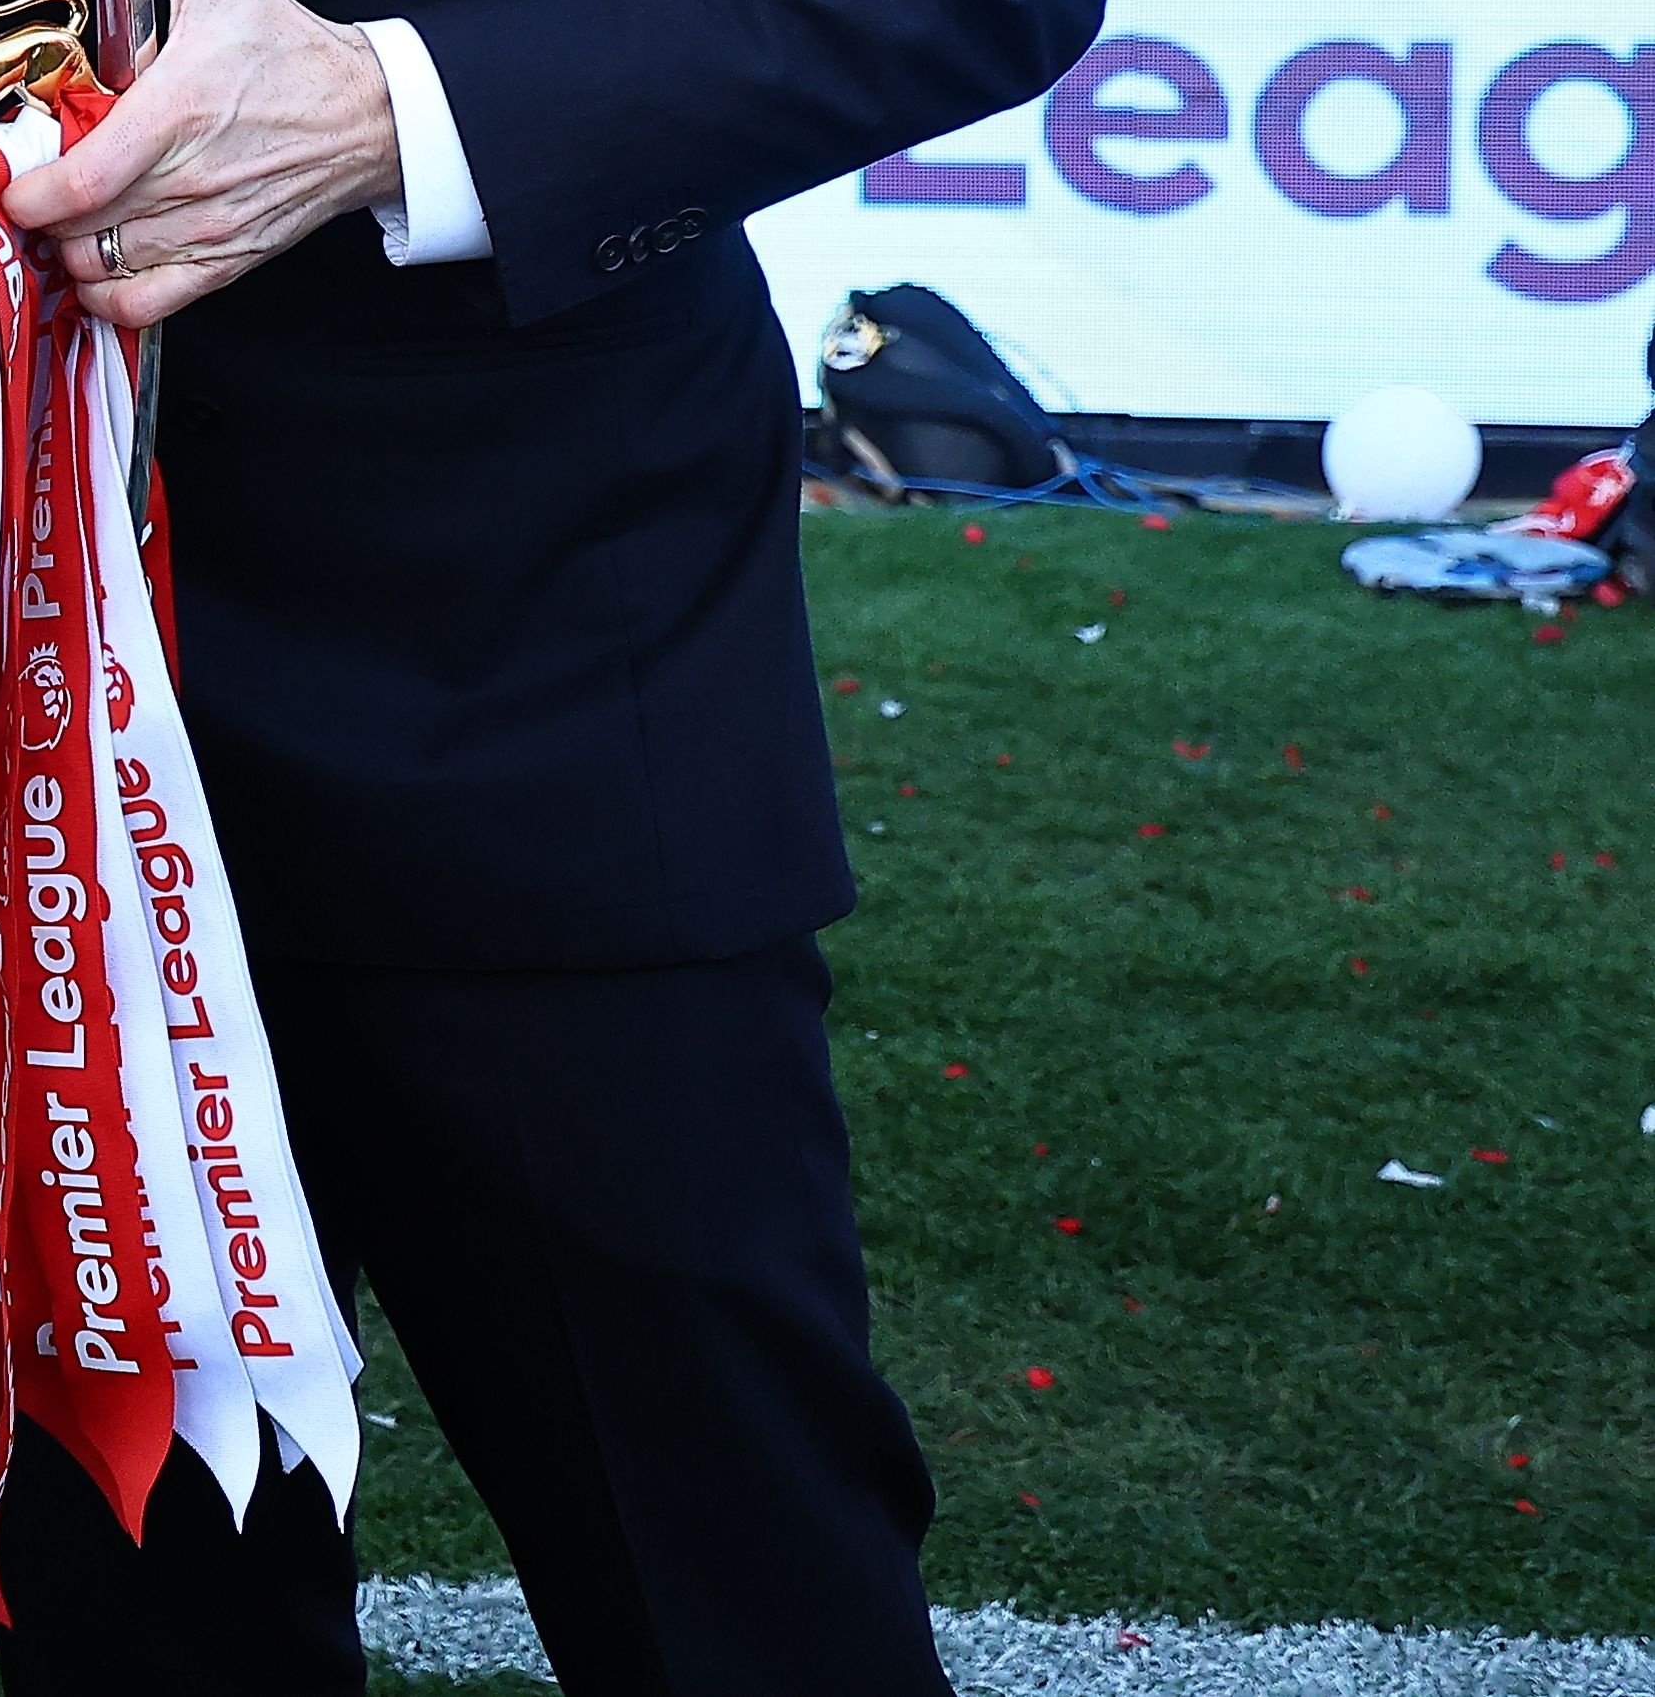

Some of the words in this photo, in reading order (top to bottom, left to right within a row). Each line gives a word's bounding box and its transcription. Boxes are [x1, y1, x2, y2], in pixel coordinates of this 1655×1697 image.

[22, 409, 61, 620] Prem
[23, 774, 87, 1070] League
[115, 757, 215, 1041] League
[41, 1091, 141, 1375] Premier
[187, 1061, 295, 1358] Premier
